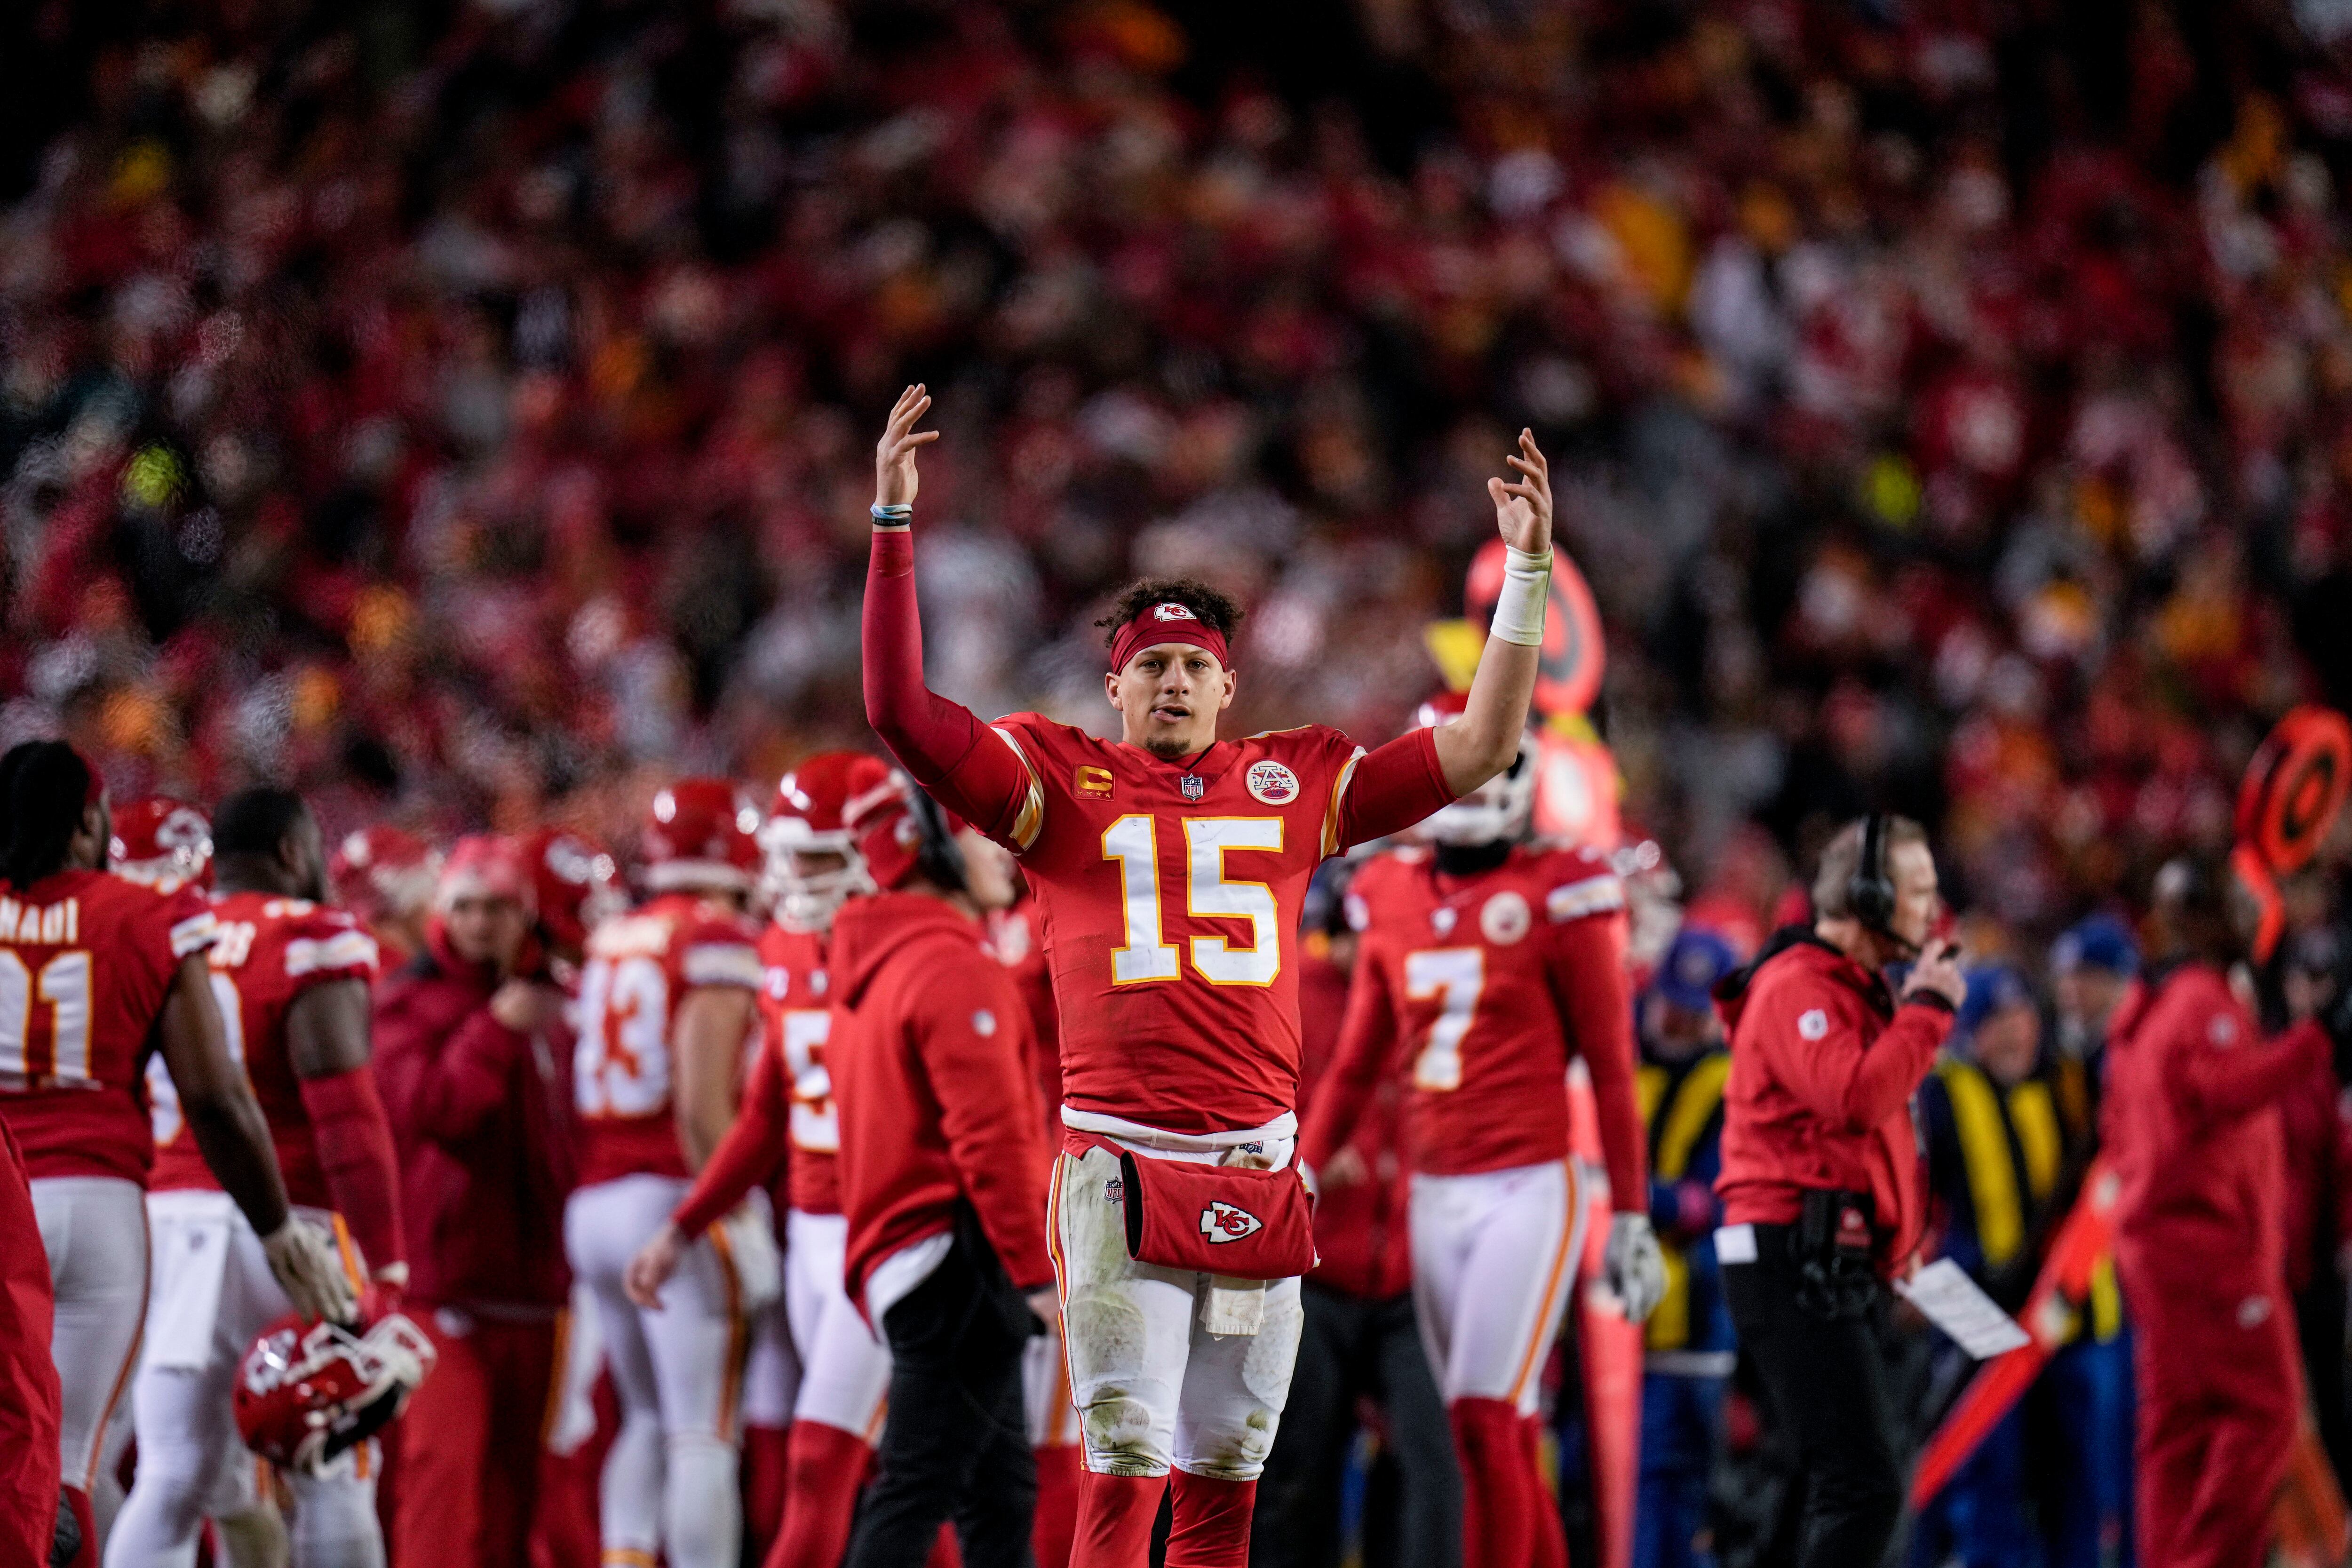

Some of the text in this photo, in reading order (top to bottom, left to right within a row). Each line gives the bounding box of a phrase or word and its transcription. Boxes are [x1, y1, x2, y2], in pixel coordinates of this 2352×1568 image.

[1164, 606, 1187, 617] KC
[1077, 765, 1112, 791] C
[1185, 786, 1200, 796] NFL
[1101, 813, 1284, 987] 15
[1405, 946, 1486, 1092] 7
[782, 1008, 840, 1153] 5
[1106, 1188, 1121, 1198] NFL
[1214, 1209, 1249, 1236] KC
